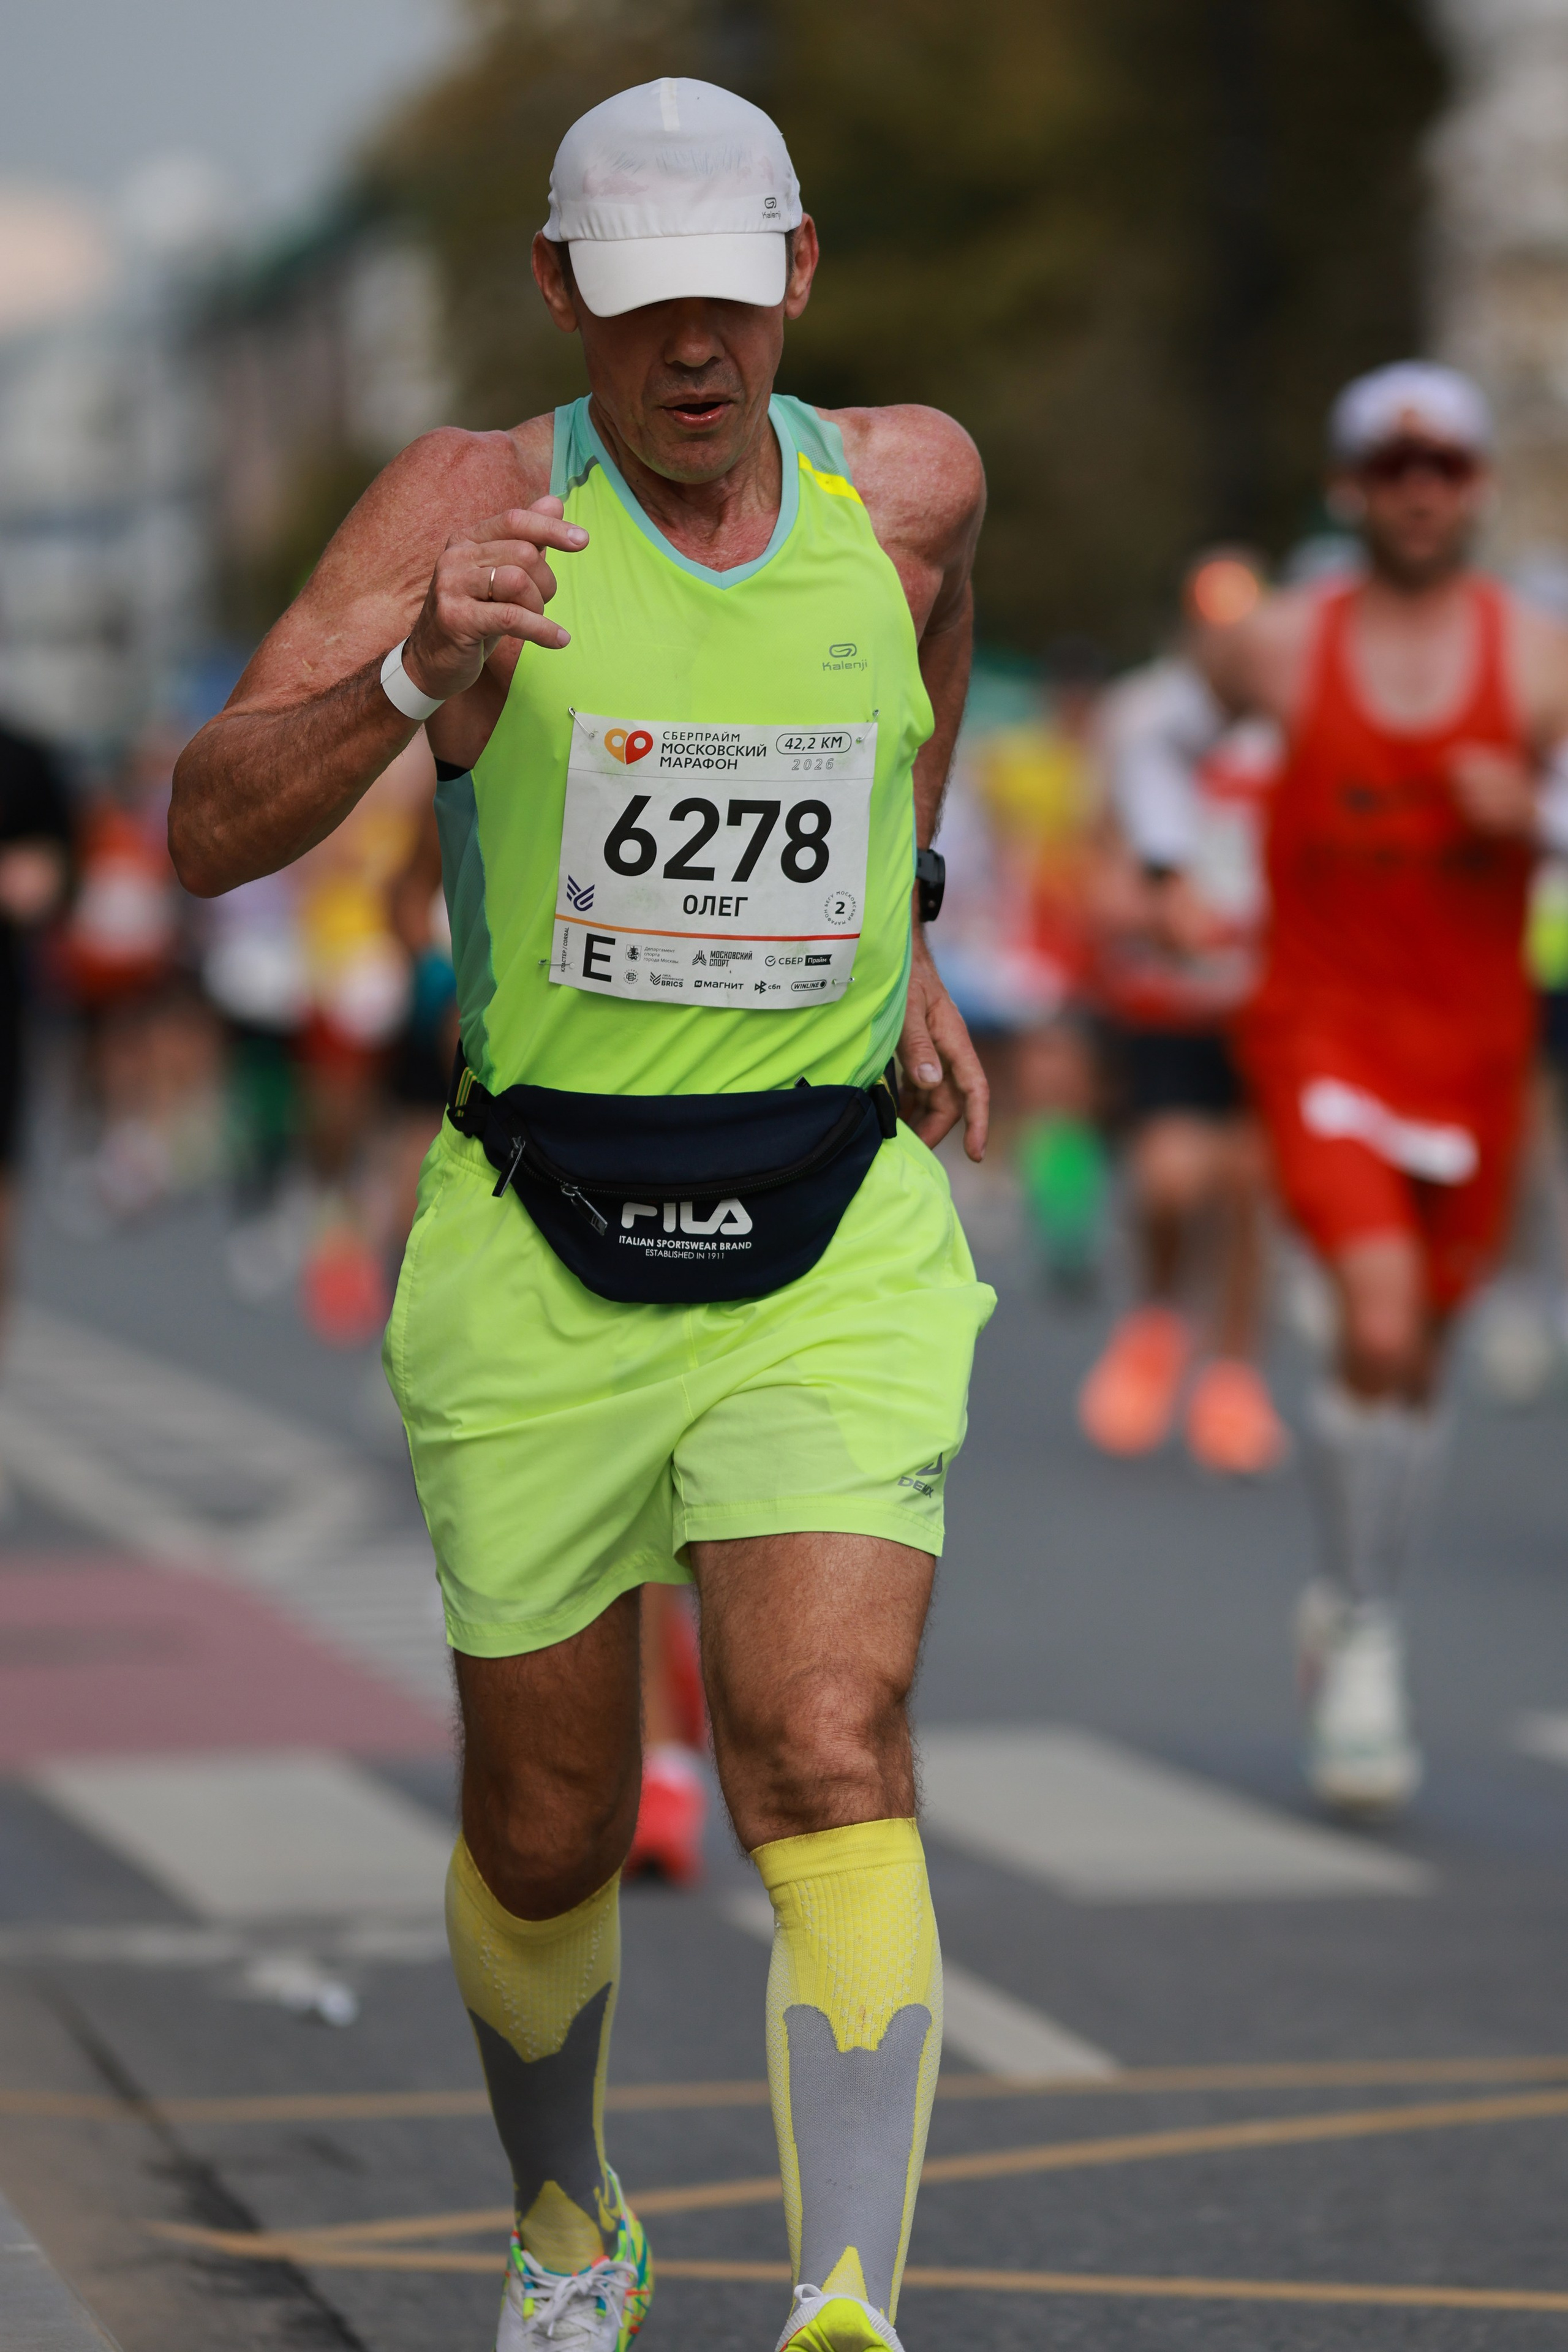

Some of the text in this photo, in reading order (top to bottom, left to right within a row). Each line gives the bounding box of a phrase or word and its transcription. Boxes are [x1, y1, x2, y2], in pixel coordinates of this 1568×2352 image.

[823, 659, 867, 671] Kalenji
[663, 731, 741, 742] СБЕРПРАЙМ
[662, 743, 767, 757] МОСКОВСКИЙ
[785, 736, 842, 751] 42,2 КМ
[660, 756, 738, 770] МАРАФОН
[791, 758, 834, 771] 2026
[603, 794, 832, 883] 6278
[683, 894, 748, 917] ОЛЕГ
[835, 902, 845, 914] 2
[582, 933, 616, 982] E
[710, 951, 753, 960] МОСКОВСКИЙ
[709, 959, 729, 967] СПОРТ
[704, 981, 744, 990] магнит
[621, 1197, 753, 1235] FILA
[619, 1235, 752, 1251] ITALIAN SPORTSWEAR BRAND
[645, 1249, 694, 1259] ESTABLISHED
